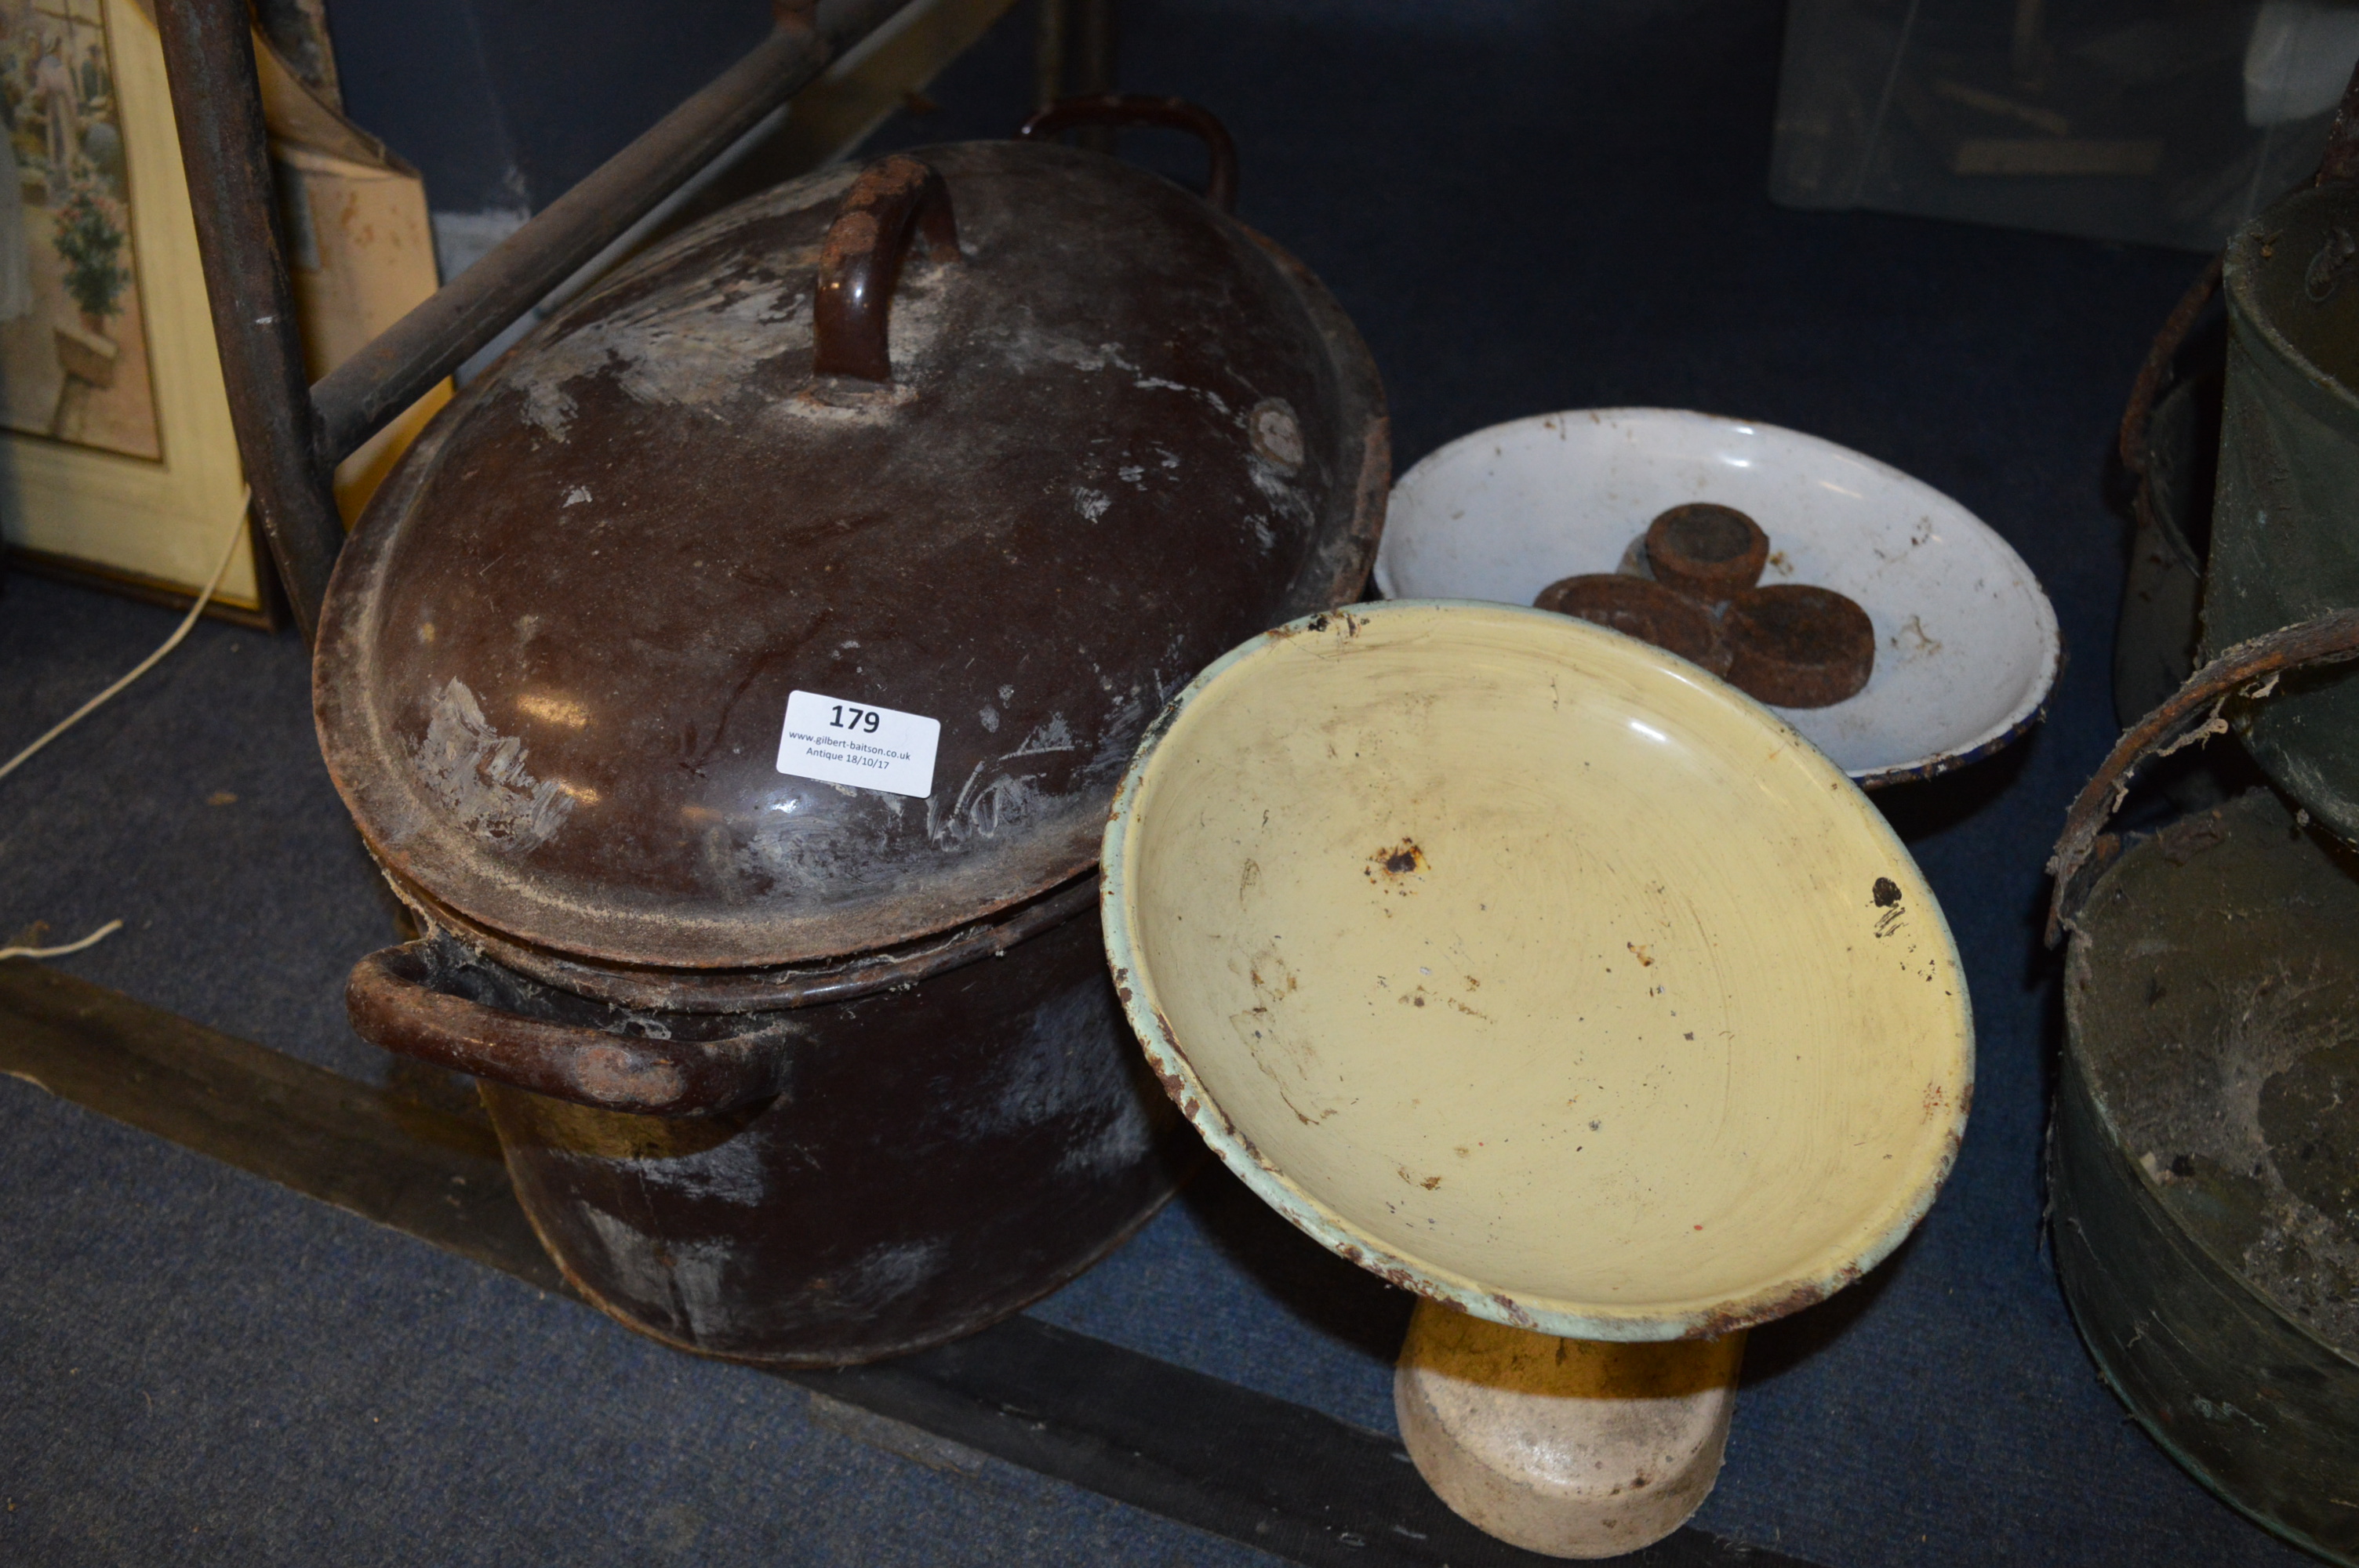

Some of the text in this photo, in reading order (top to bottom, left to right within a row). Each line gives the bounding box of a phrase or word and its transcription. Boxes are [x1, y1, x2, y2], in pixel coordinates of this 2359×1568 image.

[830, 705, 880, 733] 179
[789, 731, 911, 760] www.gilbert-baitson.co.uk
[806, 747, 889, 770] Antique 18/10/17
